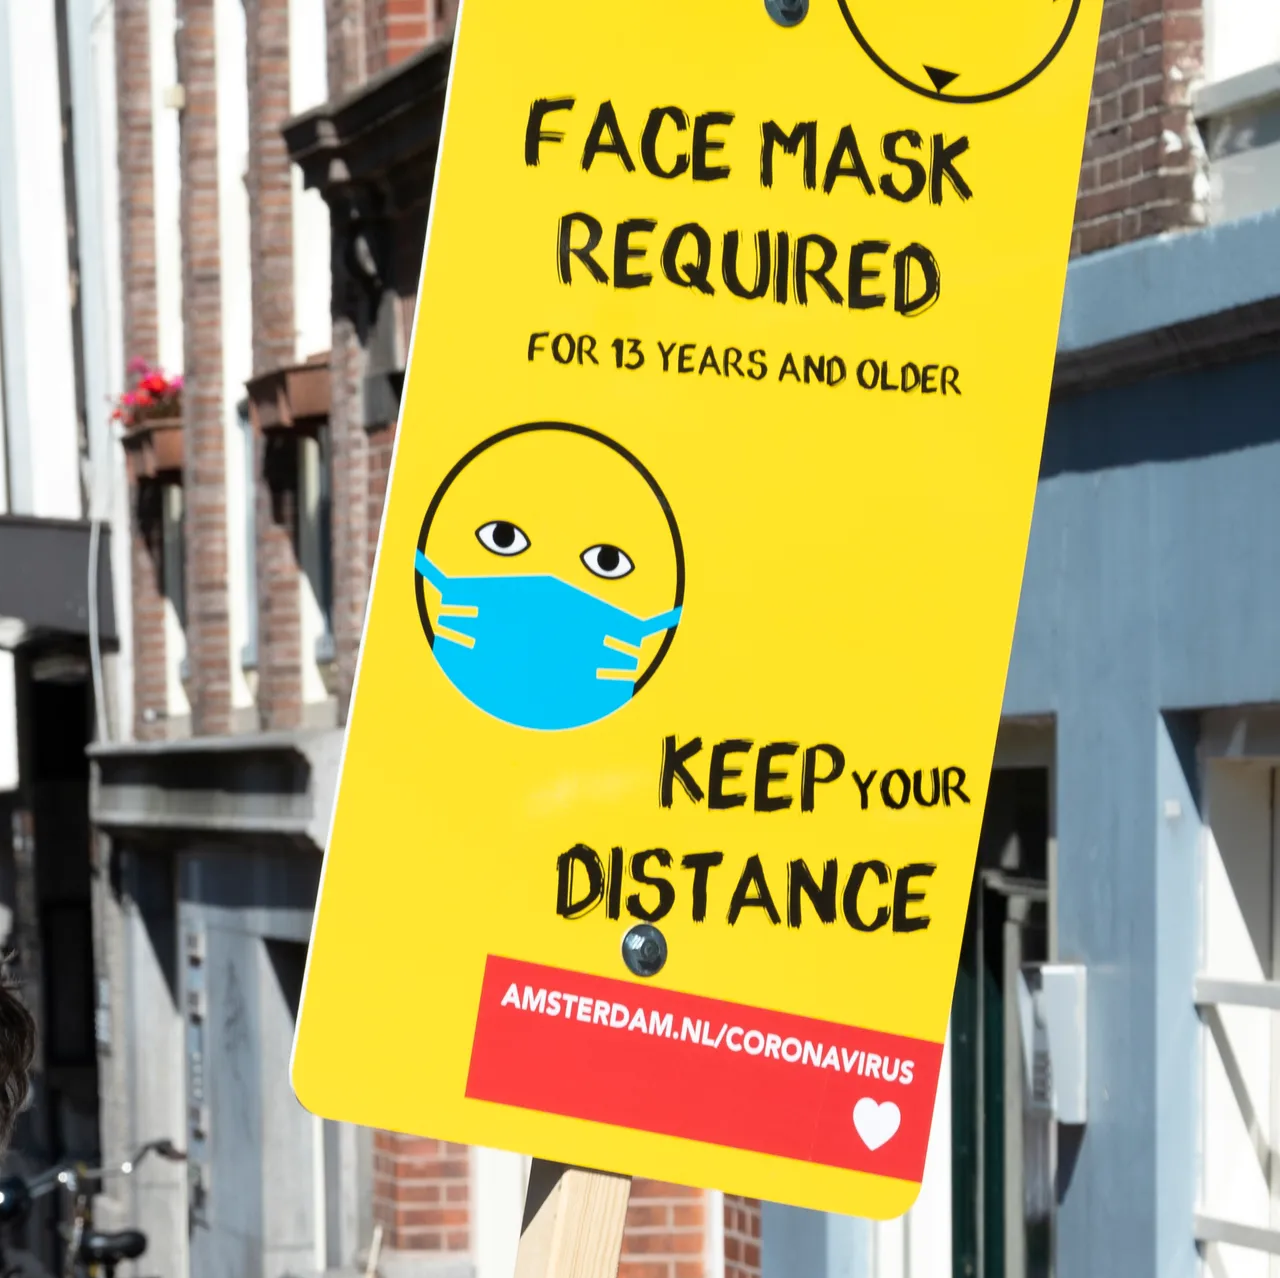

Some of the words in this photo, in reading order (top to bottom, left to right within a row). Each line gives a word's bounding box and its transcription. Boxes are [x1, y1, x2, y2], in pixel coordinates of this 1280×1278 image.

[525, 99, 735, 181] FACE
[760, 120, 973, 206] MASK
[559, 211, 941, 316] REQUIRED
[527, 332, 599, 364] FOR
[611, 338, 645, 370] 13
[657, 341, 768, 381] YEARS
[778, 352, 847, 387] AND
[856, 359, 963, 395] OLDER
[661, 735, 846, 813] KEEP
[851, 766, 971, 810] YOUR
[556, 843, 937, 933] DISTANCE
[500, 983, 915, 1085] AMSTERDAM.NL/CORONAVIRUS
